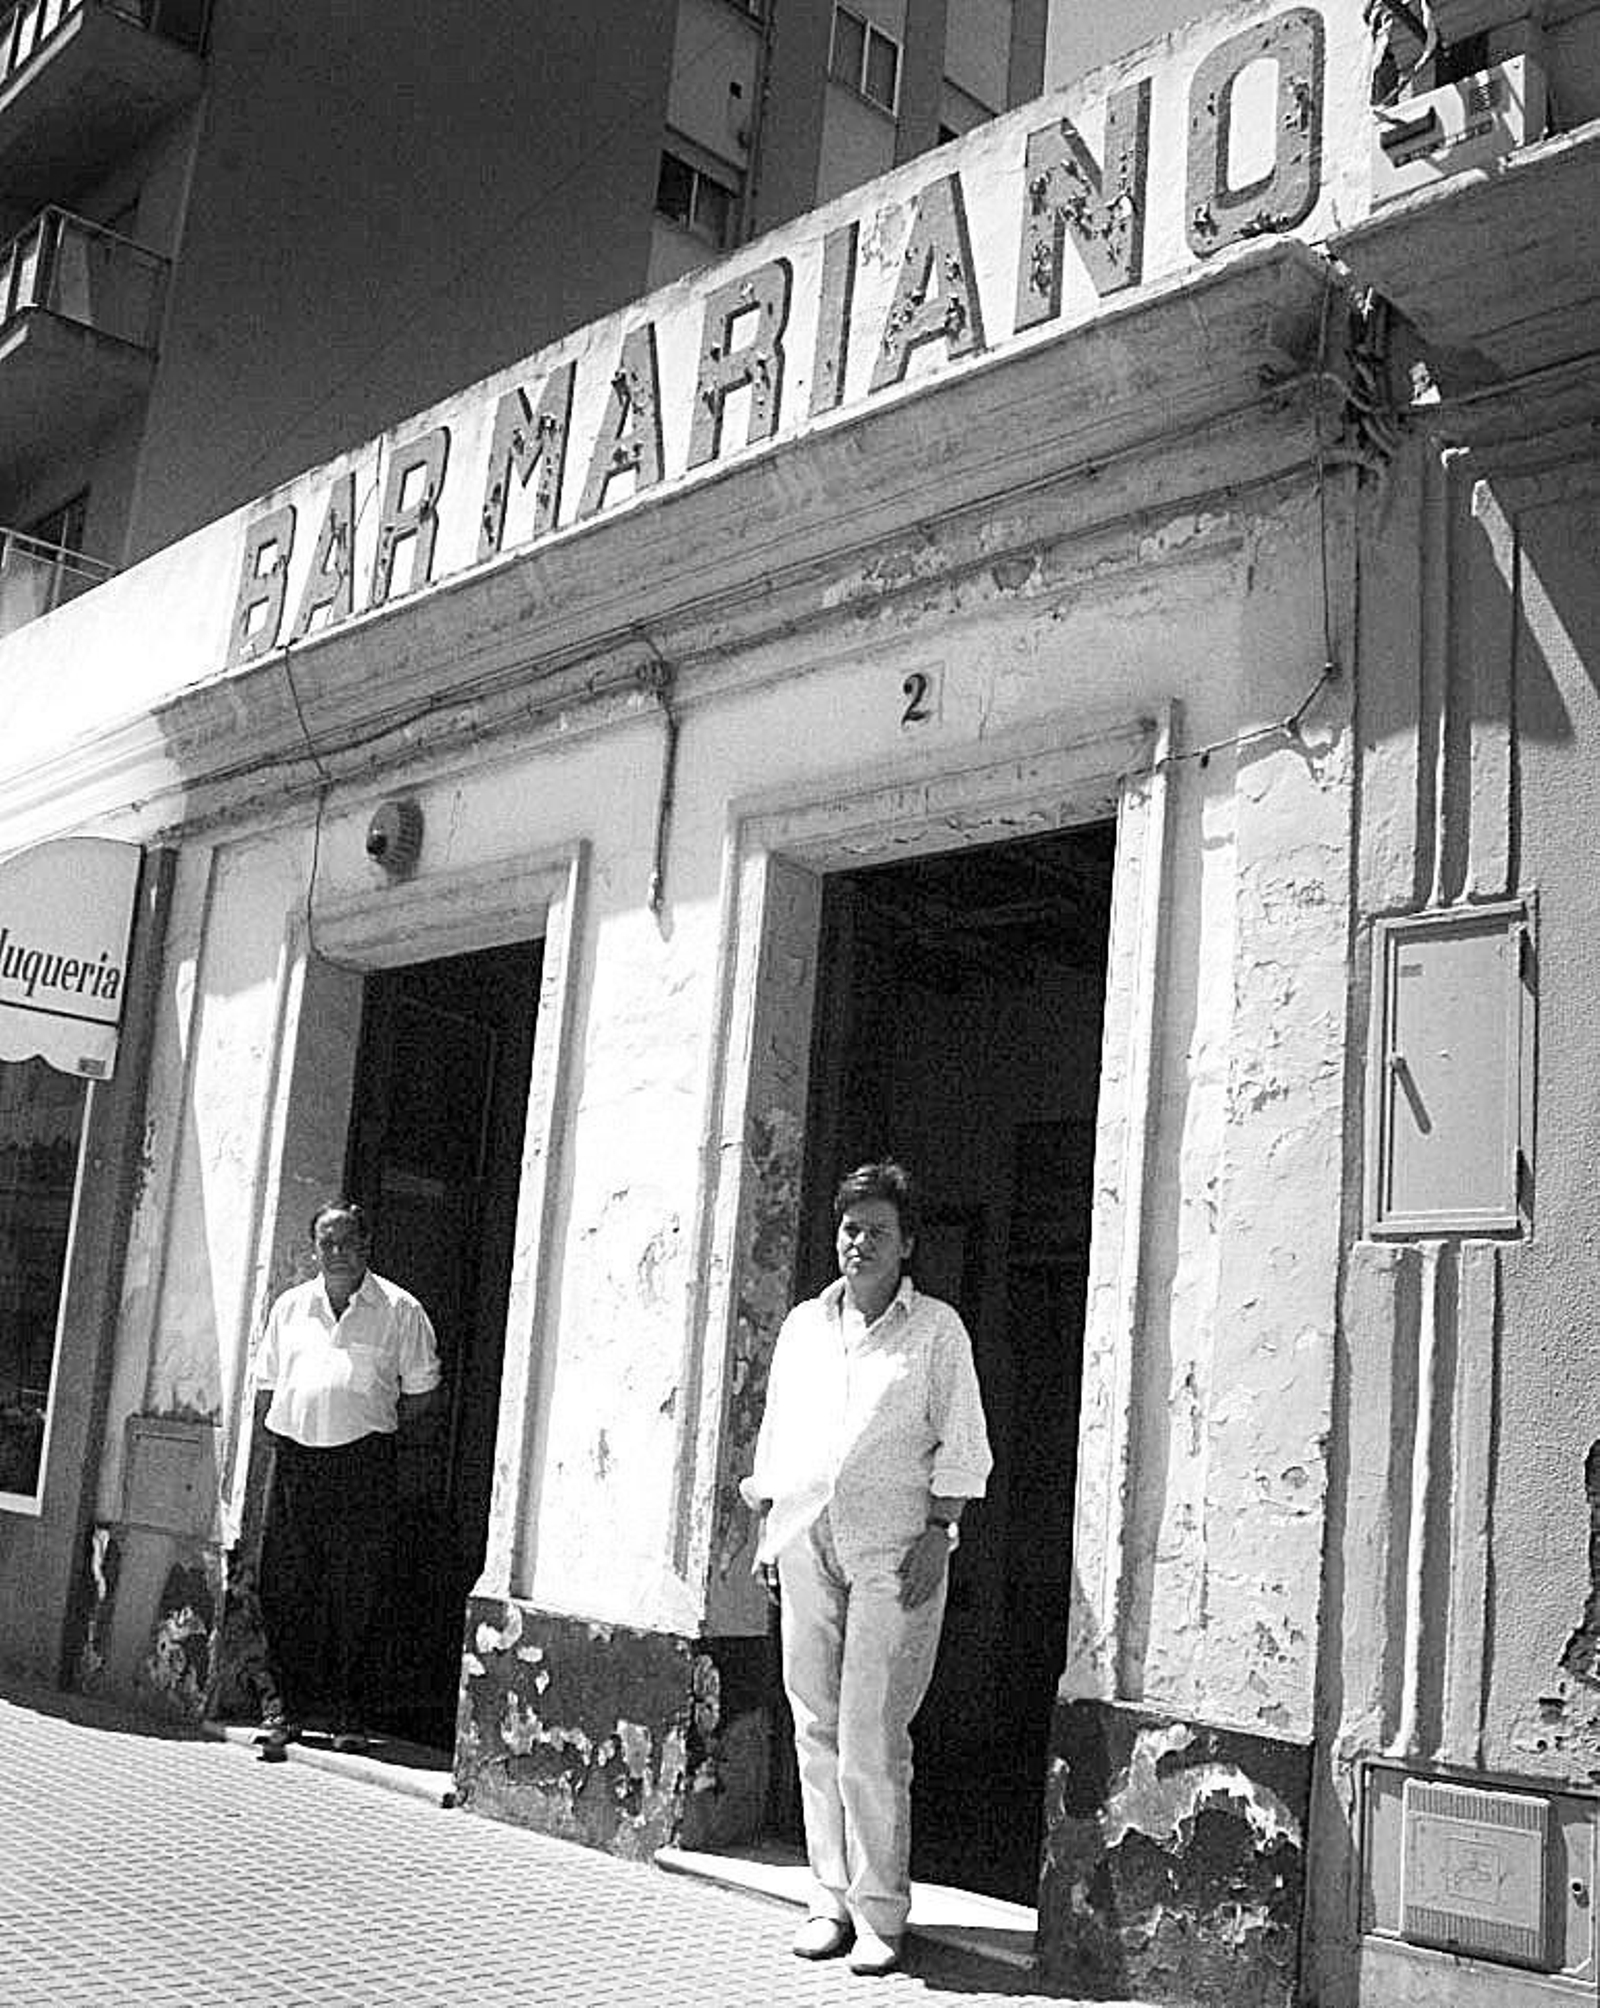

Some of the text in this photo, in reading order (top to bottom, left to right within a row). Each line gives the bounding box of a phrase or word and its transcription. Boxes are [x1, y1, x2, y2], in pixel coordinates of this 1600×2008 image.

[226, 7, 1325, 667] BAR MARIANO
[901, 672, 931, 725] 2
